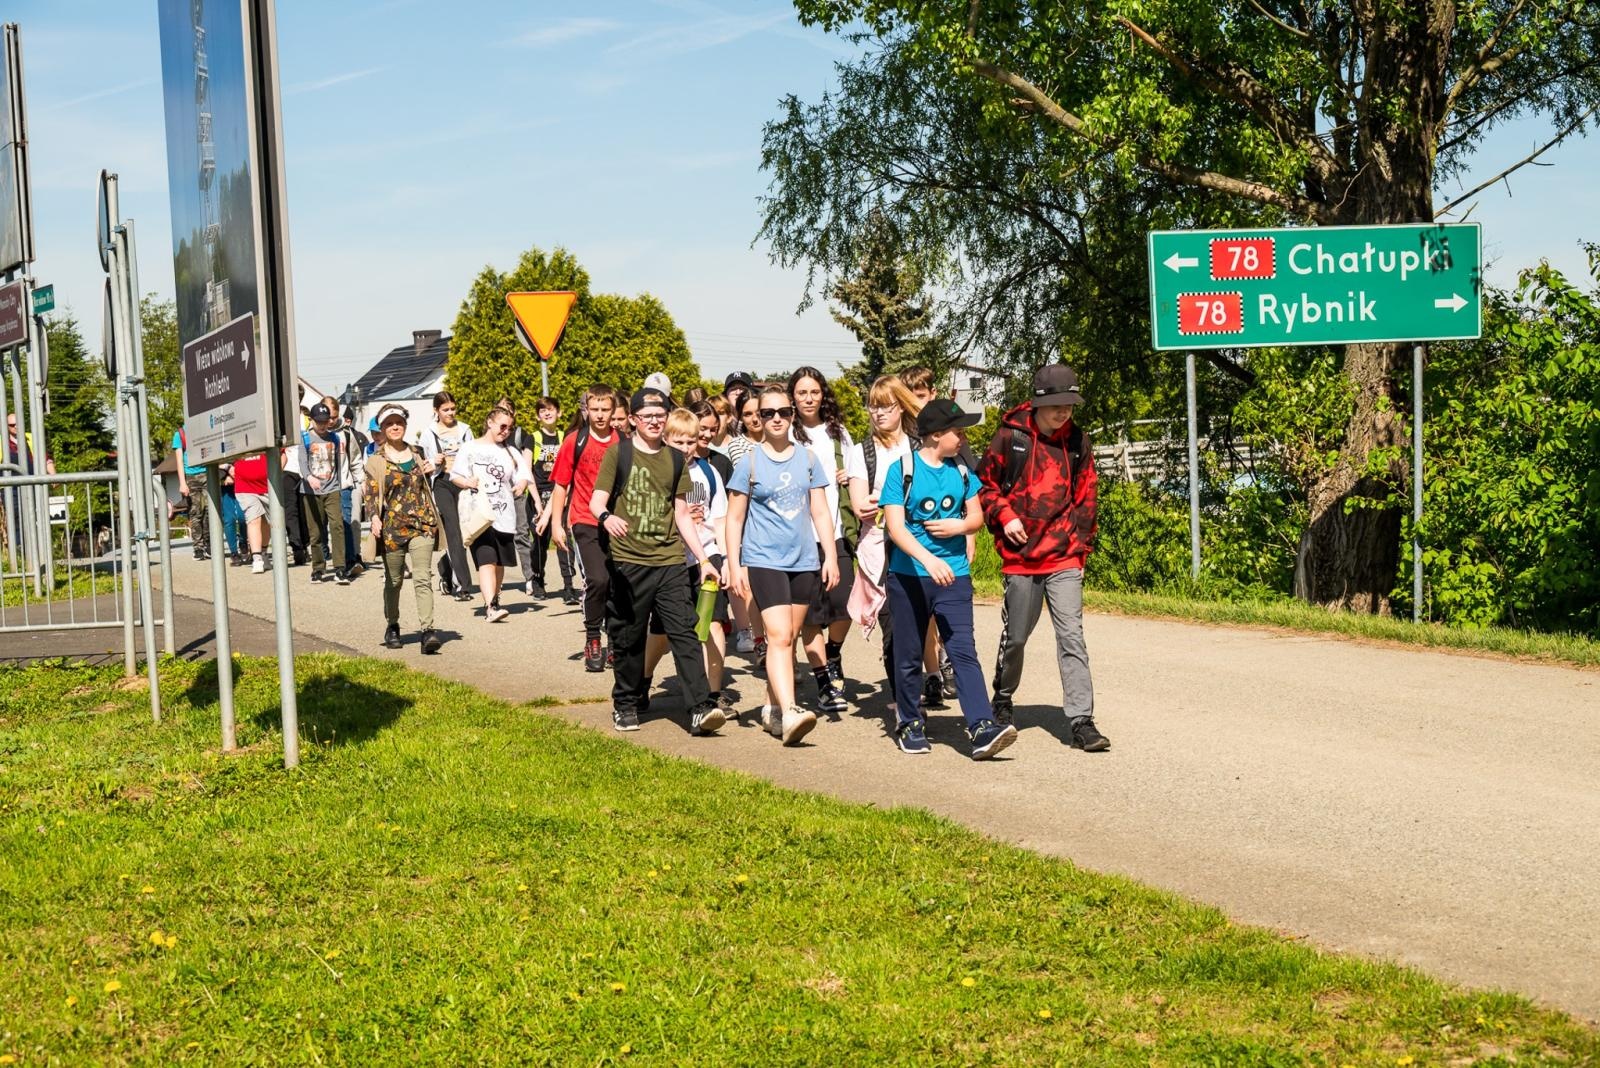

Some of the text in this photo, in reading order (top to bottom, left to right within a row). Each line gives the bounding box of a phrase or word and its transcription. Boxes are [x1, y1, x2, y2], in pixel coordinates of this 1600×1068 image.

[1227, 240, 1450, 281] 78 Chałupki
[1195, 291, 1377, 333] 78 Rybnik
[210, 338, 235, 365] widokowa
[204, 371, 230, 400] Rozhledna
